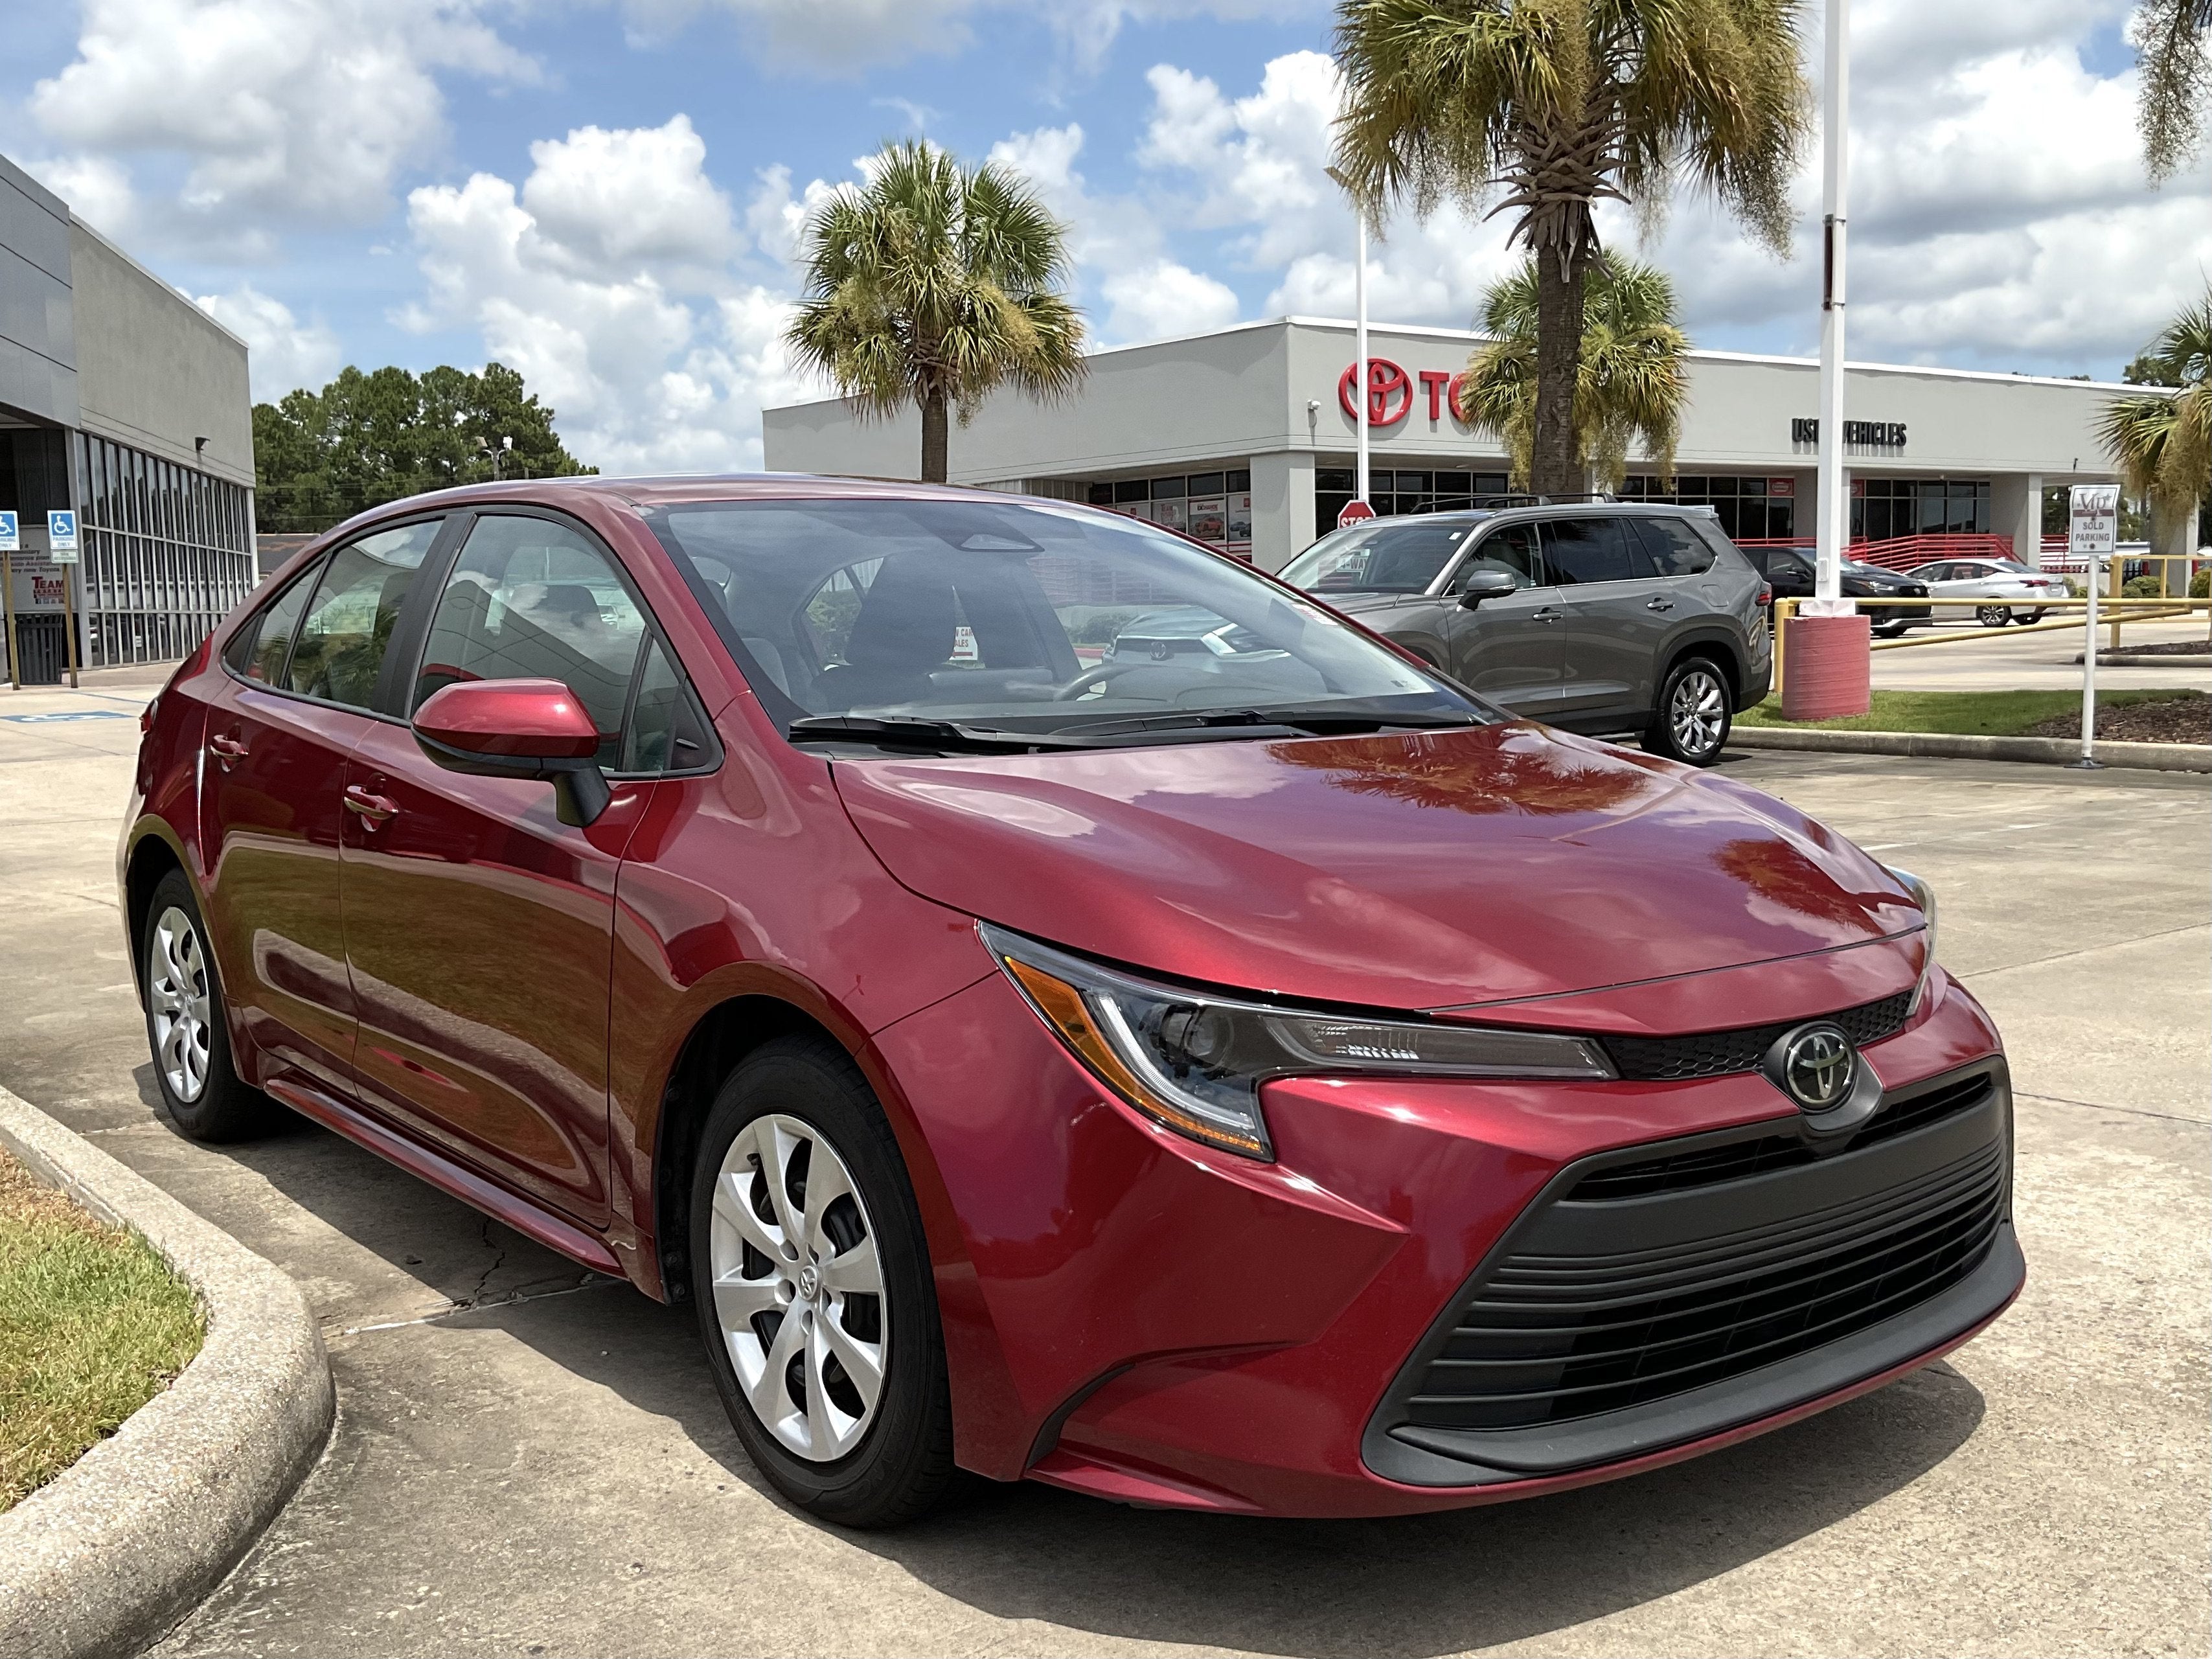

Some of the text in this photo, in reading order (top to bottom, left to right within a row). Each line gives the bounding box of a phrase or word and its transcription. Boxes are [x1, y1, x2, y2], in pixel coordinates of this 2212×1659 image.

[2083, 521, 2104, 530] SOLD
[2075, 533, 2110, 542] PARKING
[32, 577, 64, 589] TEAM
